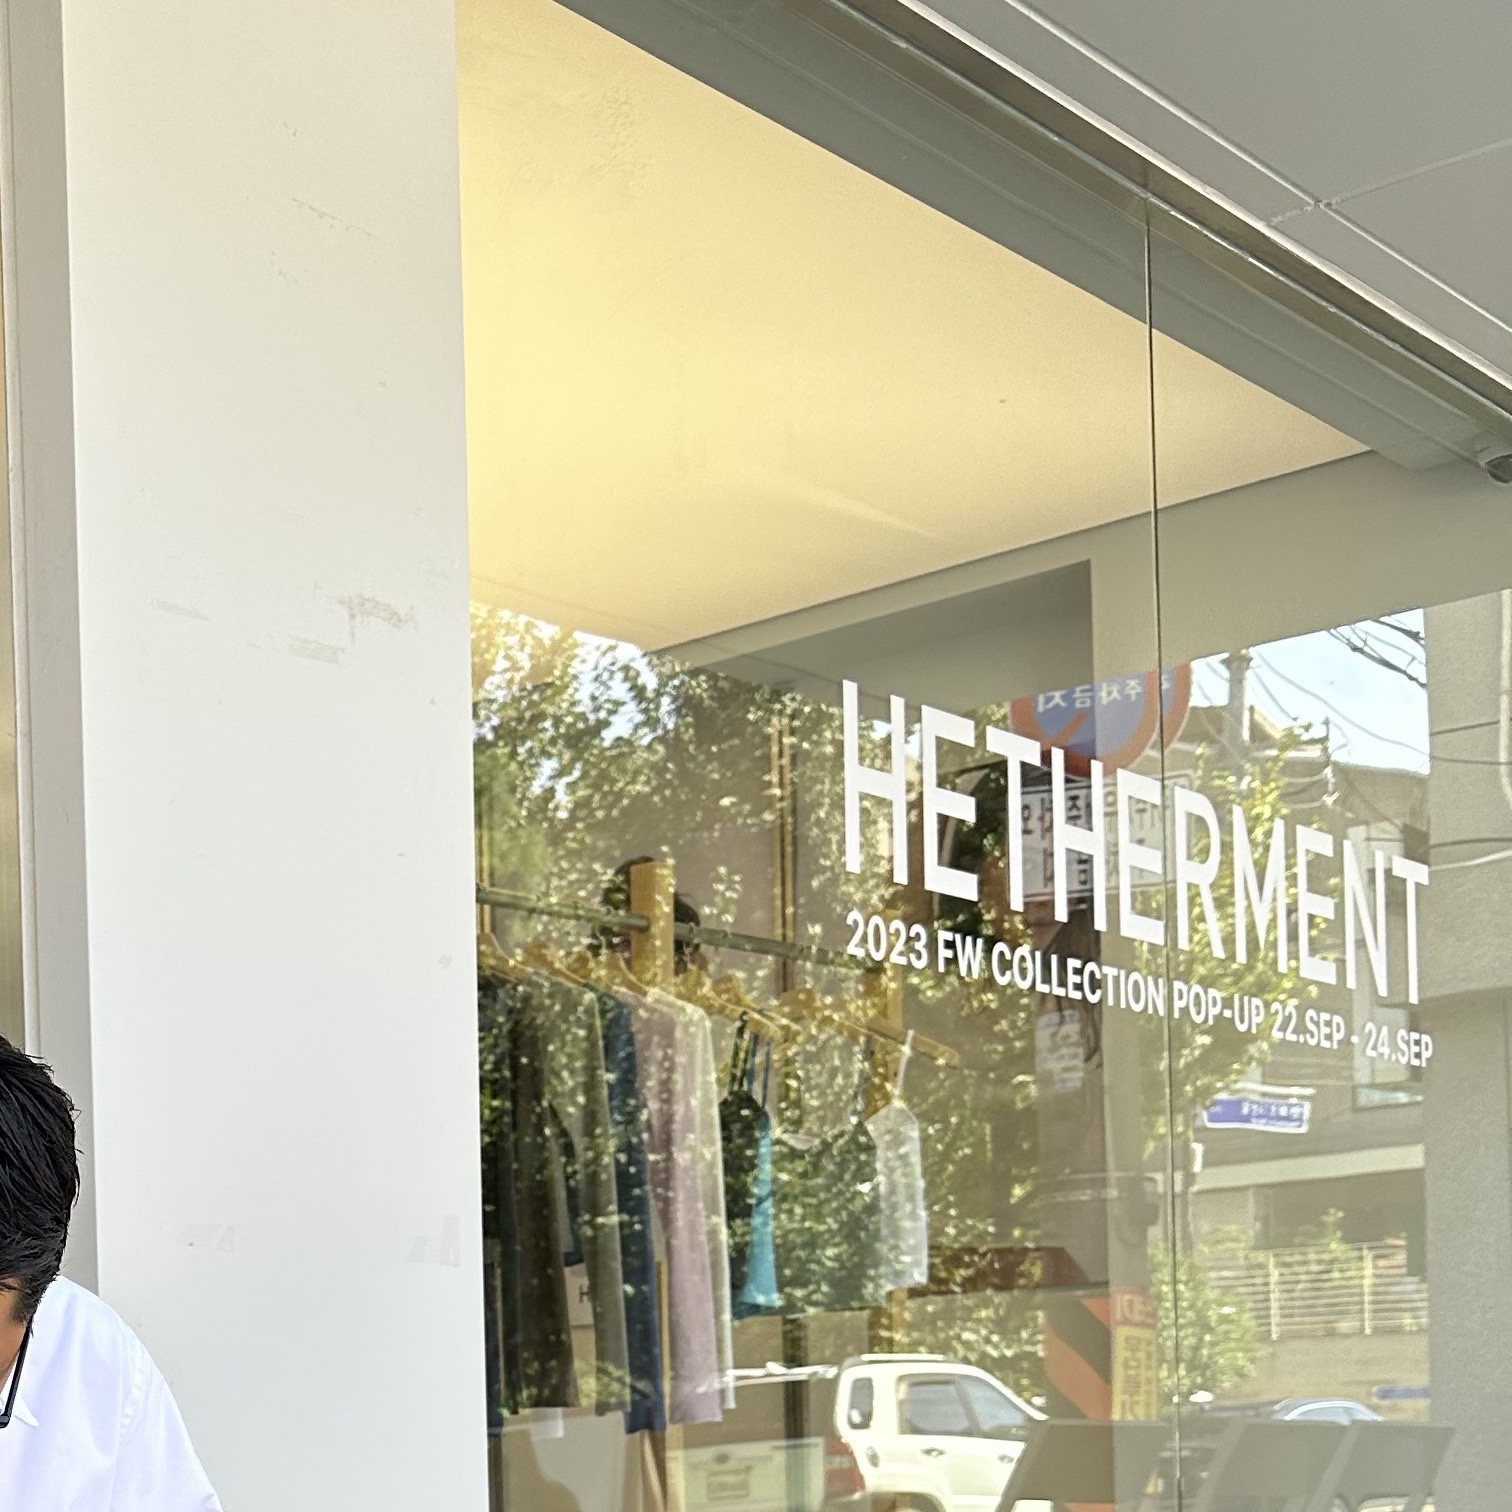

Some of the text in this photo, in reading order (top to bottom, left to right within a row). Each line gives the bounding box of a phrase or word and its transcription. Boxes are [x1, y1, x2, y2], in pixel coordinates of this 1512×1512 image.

[842, 679, 1429, 1004] HETHERMENT
[846, 908, 928, 970] 2023
[937, 930, 983, 980] FW
[992, 942, 1165, 1017] COLLECTION
[1173, 980, 1265, 1035] POP-UP
[1271, 1001, 1345, 1050] 22.SEP
[1364, 1021, 1434, 1068] 24.SEP
